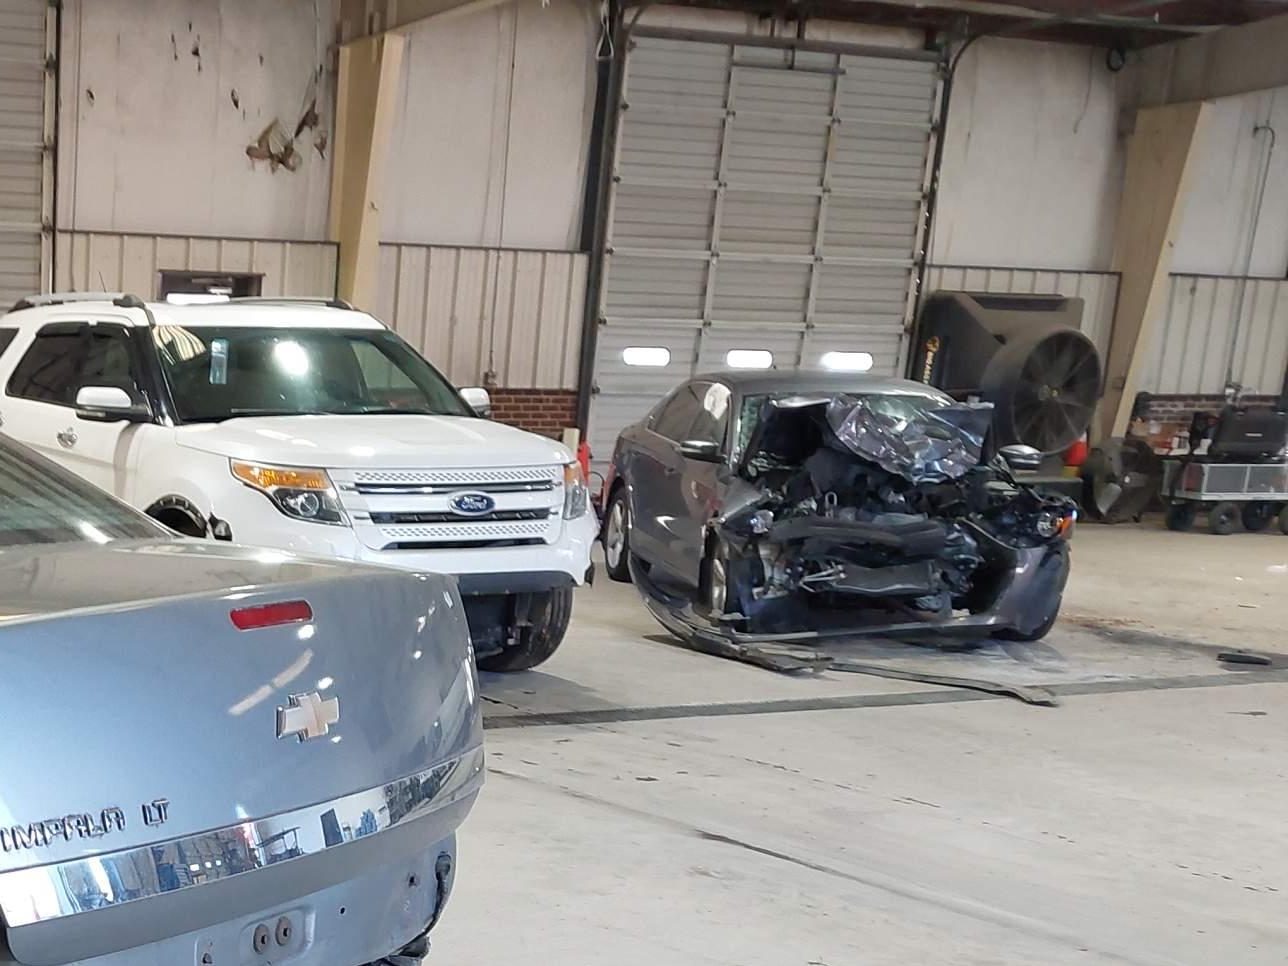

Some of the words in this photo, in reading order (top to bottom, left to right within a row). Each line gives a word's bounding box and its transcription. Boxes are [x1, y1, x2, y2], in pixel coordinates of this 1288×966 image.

[460, 495, 488, 510] Ford
[0, 806, 126, 852] IMPALA
[141, 797, 170, 829] LT
